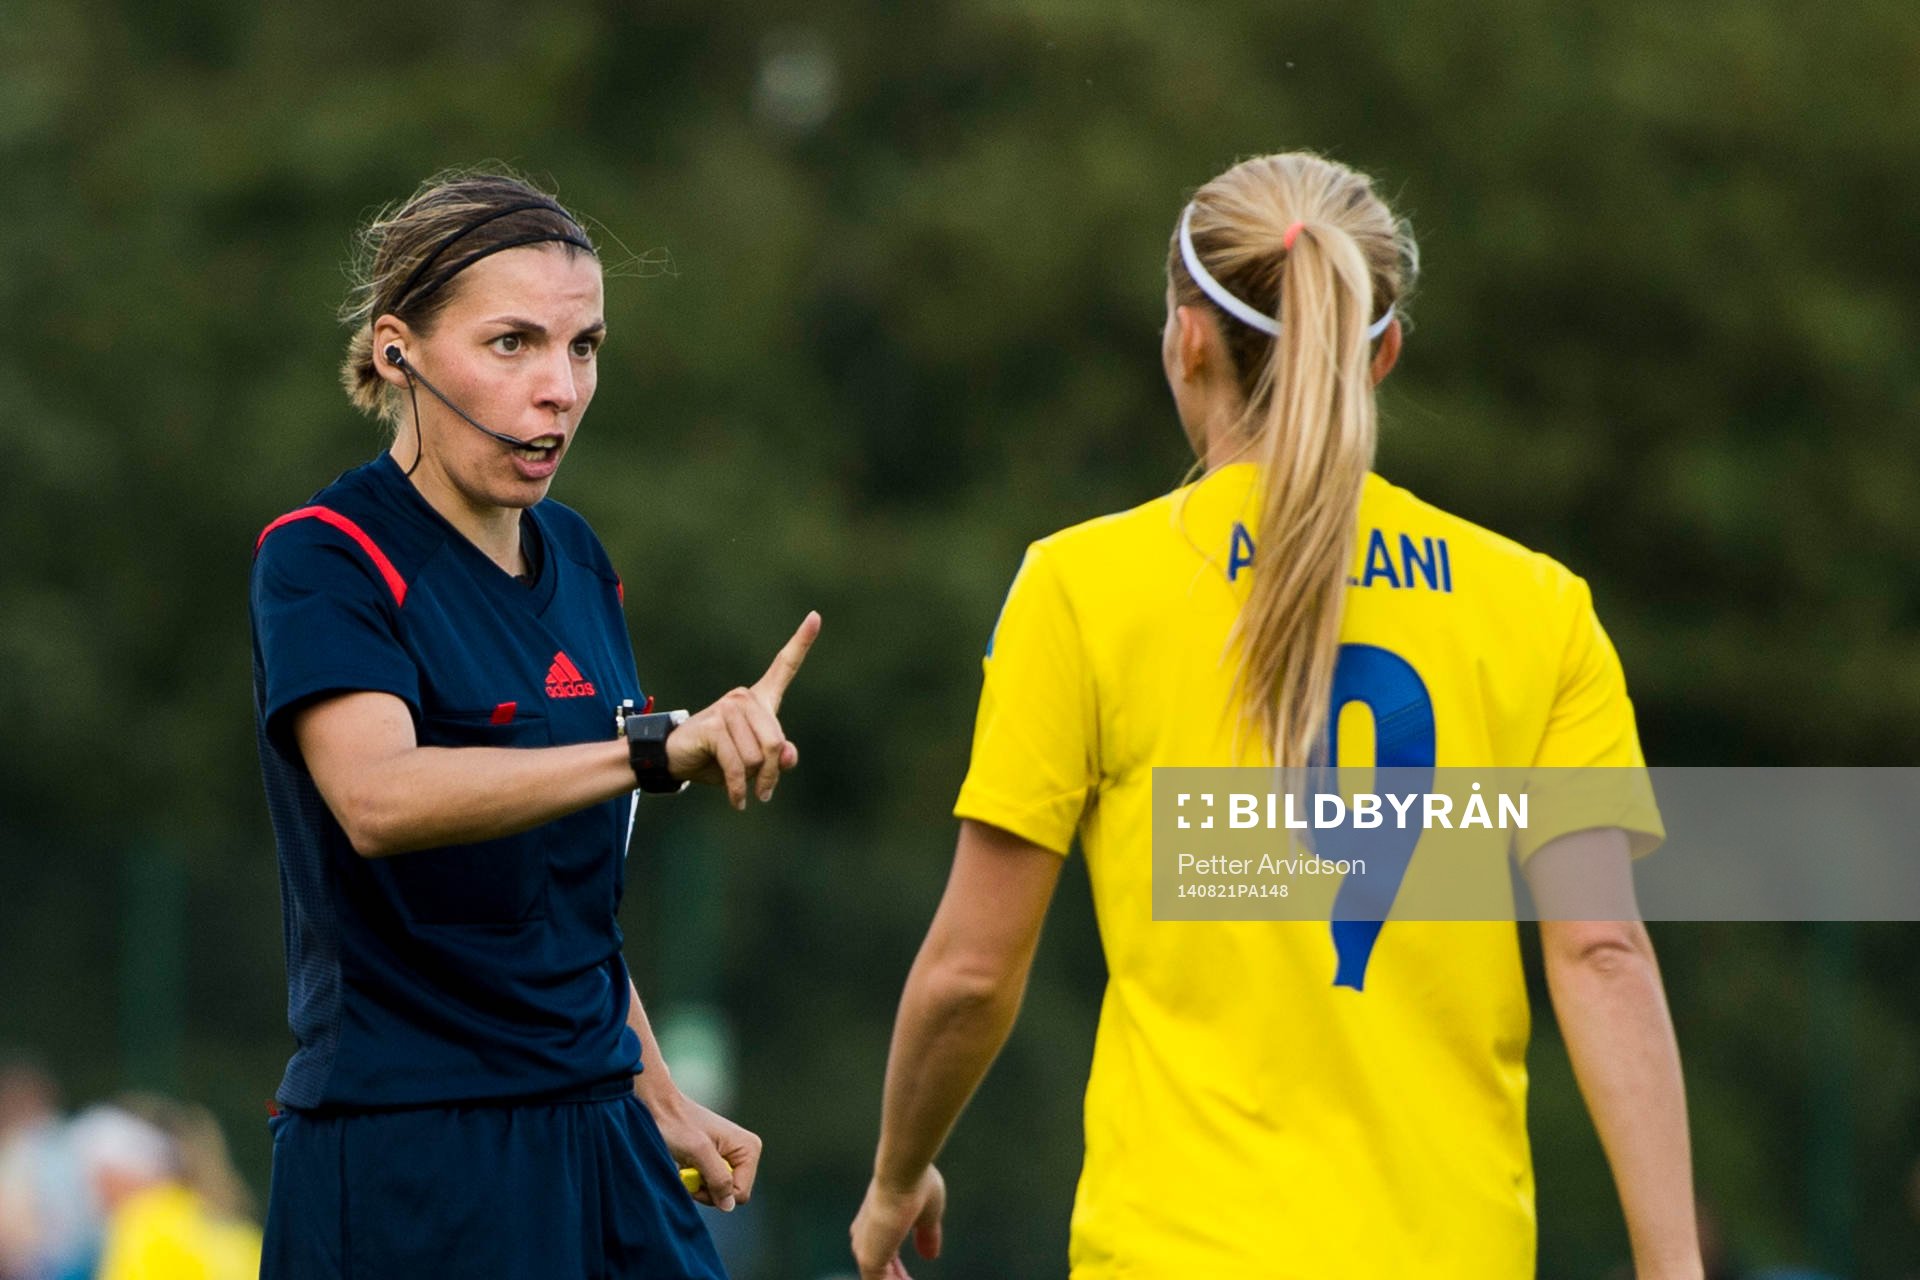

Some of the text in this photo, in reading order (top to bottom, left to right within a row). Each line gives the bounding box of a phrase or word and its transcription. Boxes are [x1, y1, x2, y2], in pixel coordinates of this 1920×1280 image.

[1227, 521, 1452, 592] AANI
[545, 680, 596, 698] adidas
[1306, 642, 1436, 992] 9
